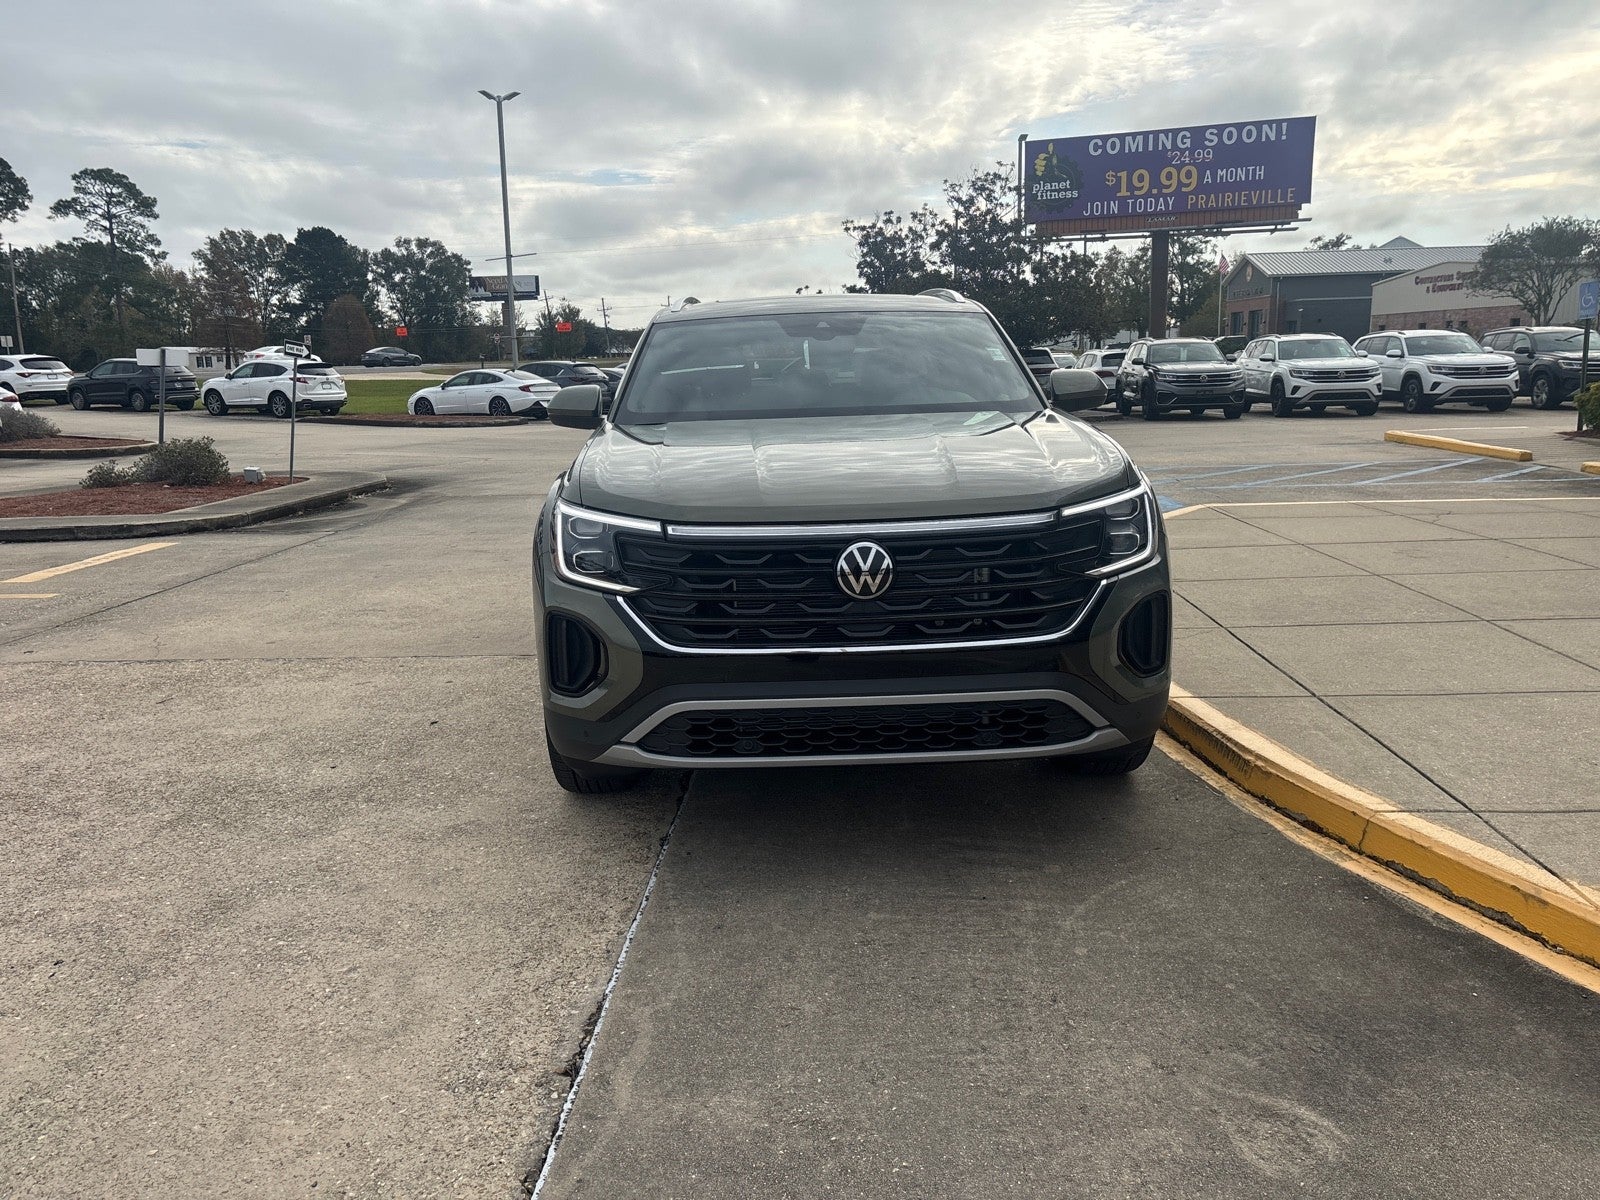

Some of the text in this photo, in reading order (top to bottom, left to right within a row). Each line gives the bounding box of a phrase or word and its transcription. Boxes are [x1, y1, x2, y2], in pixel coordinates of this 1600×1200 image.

[1088, 122, 1288, 156] COMING SOON!
[1167, 148, 1213, 165] $24.99
[1032, 180, 1071, 194] planet
[1105, 165, 1265, 197] $19.99 A MONTH
[1037, 190, 1078, 200] fitness
[1083, 187, 1296, 216] JOIN TODAY PRAIRIEVILLE
